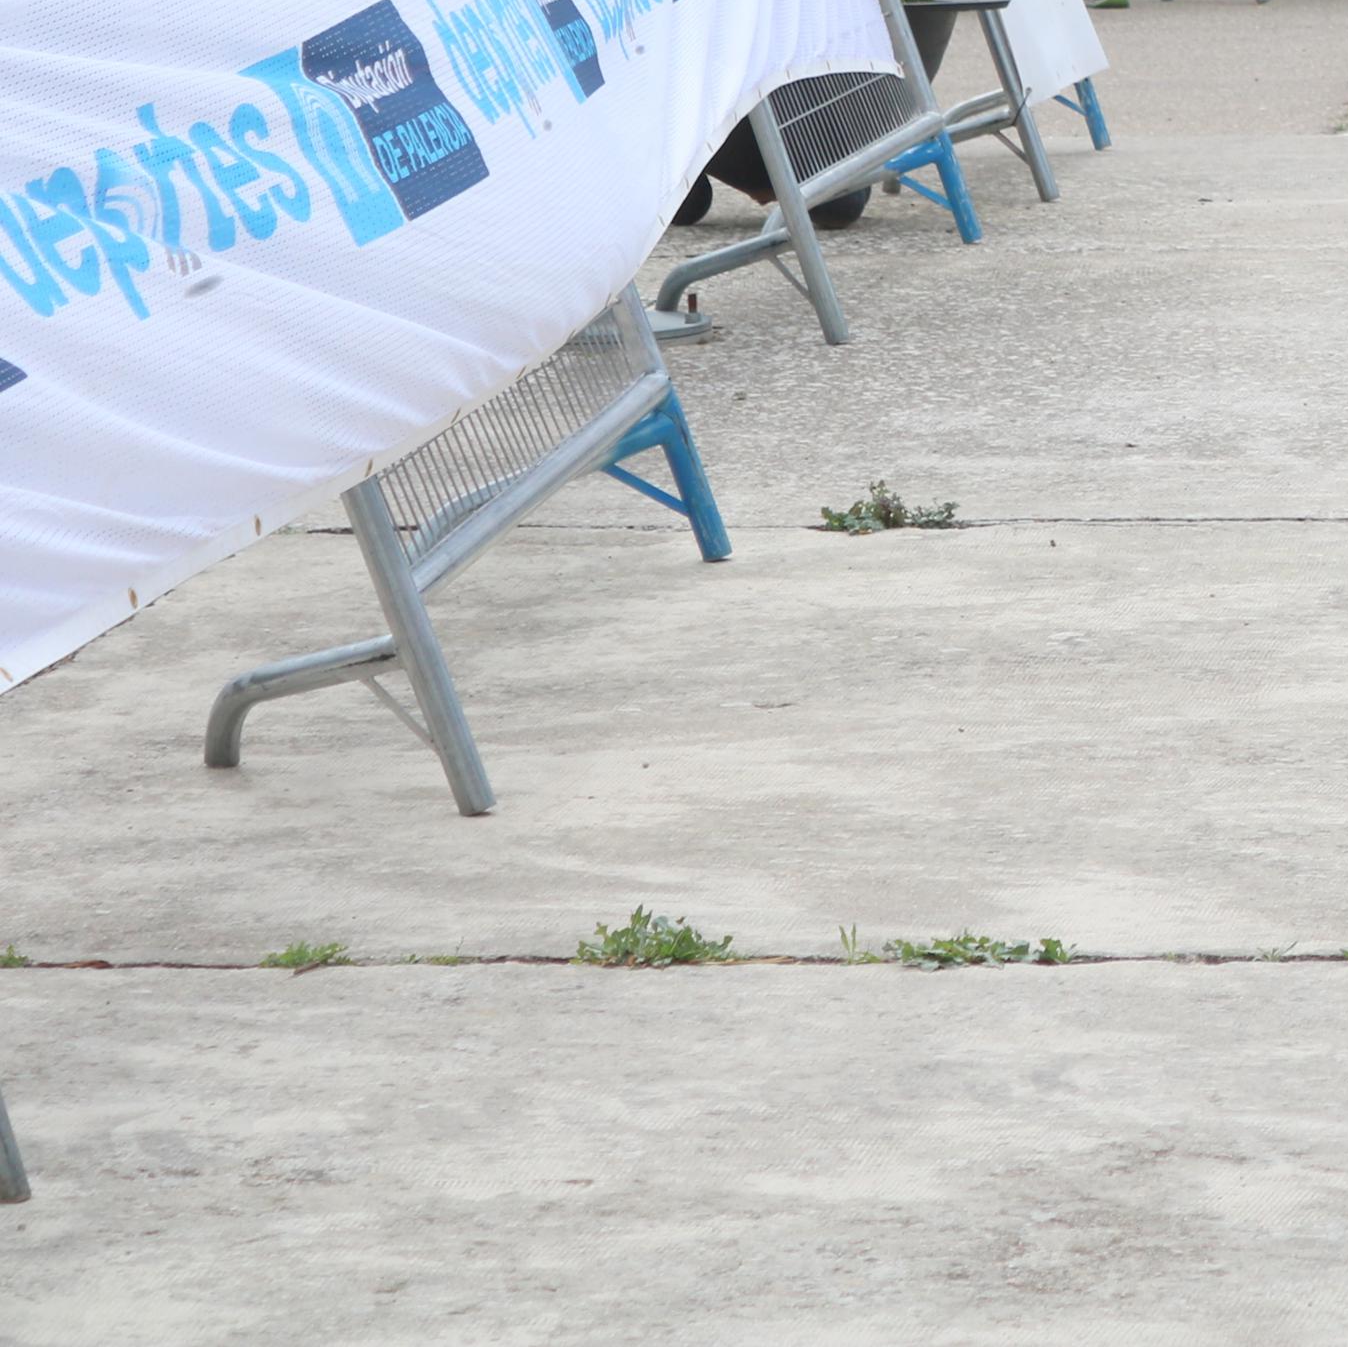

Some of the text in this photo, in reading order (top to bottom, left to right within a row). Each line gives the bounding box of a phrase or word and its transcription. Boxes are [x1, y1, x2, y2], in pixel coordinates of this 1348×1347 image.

[317, 39, 413, 114] Diputación
[371, 100, 471, 184] DE PALENCIA
